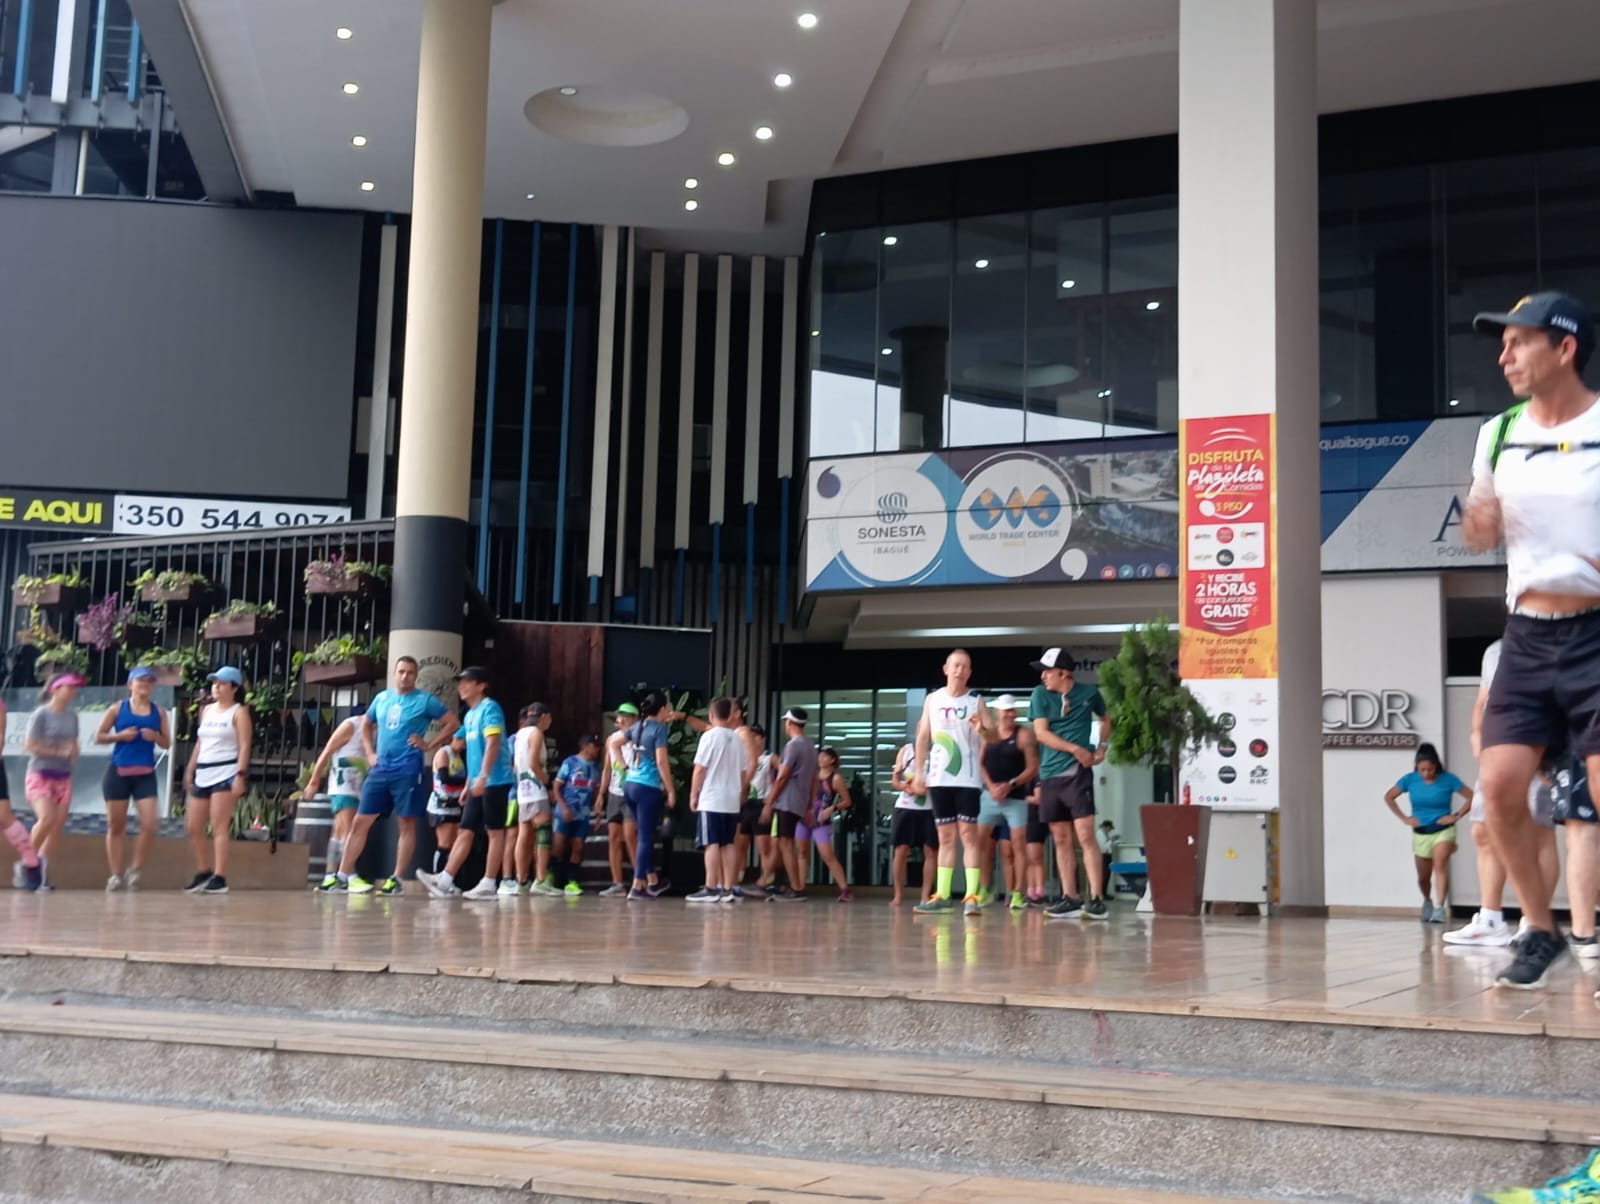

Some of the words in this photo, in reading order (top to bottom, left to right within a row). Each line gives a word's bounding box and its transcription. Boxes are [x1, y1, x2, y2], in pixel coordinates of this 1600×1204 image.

[1188, 449, 1264, 465] DISFRUTA
[1187, 463, 1264, 499] Plazoleta
[23, 499, 102, 524] AQUI
[1223, 501, 1243, 511] PISO
[201, 508, 263, 530] 544
[858, 525, 926, 539] SONESTA
[968, 532, 997, 541] WORLD
[999, 531, 1025, 539] TRADE
[1027, 529, 1060, 538] CENTER
[1215, 573, 1245, 582] RECIBE
[1196, 583, 1206, 597] 2
[1207, 582, 1257, 596] HORAS
[1217, 637, 1257, 645] compras
[1206, 648, 1238, 656] iguales
[1321, 688, 1412, 729] CDR
[1355, 735, 1415, 746] ROASTERS
